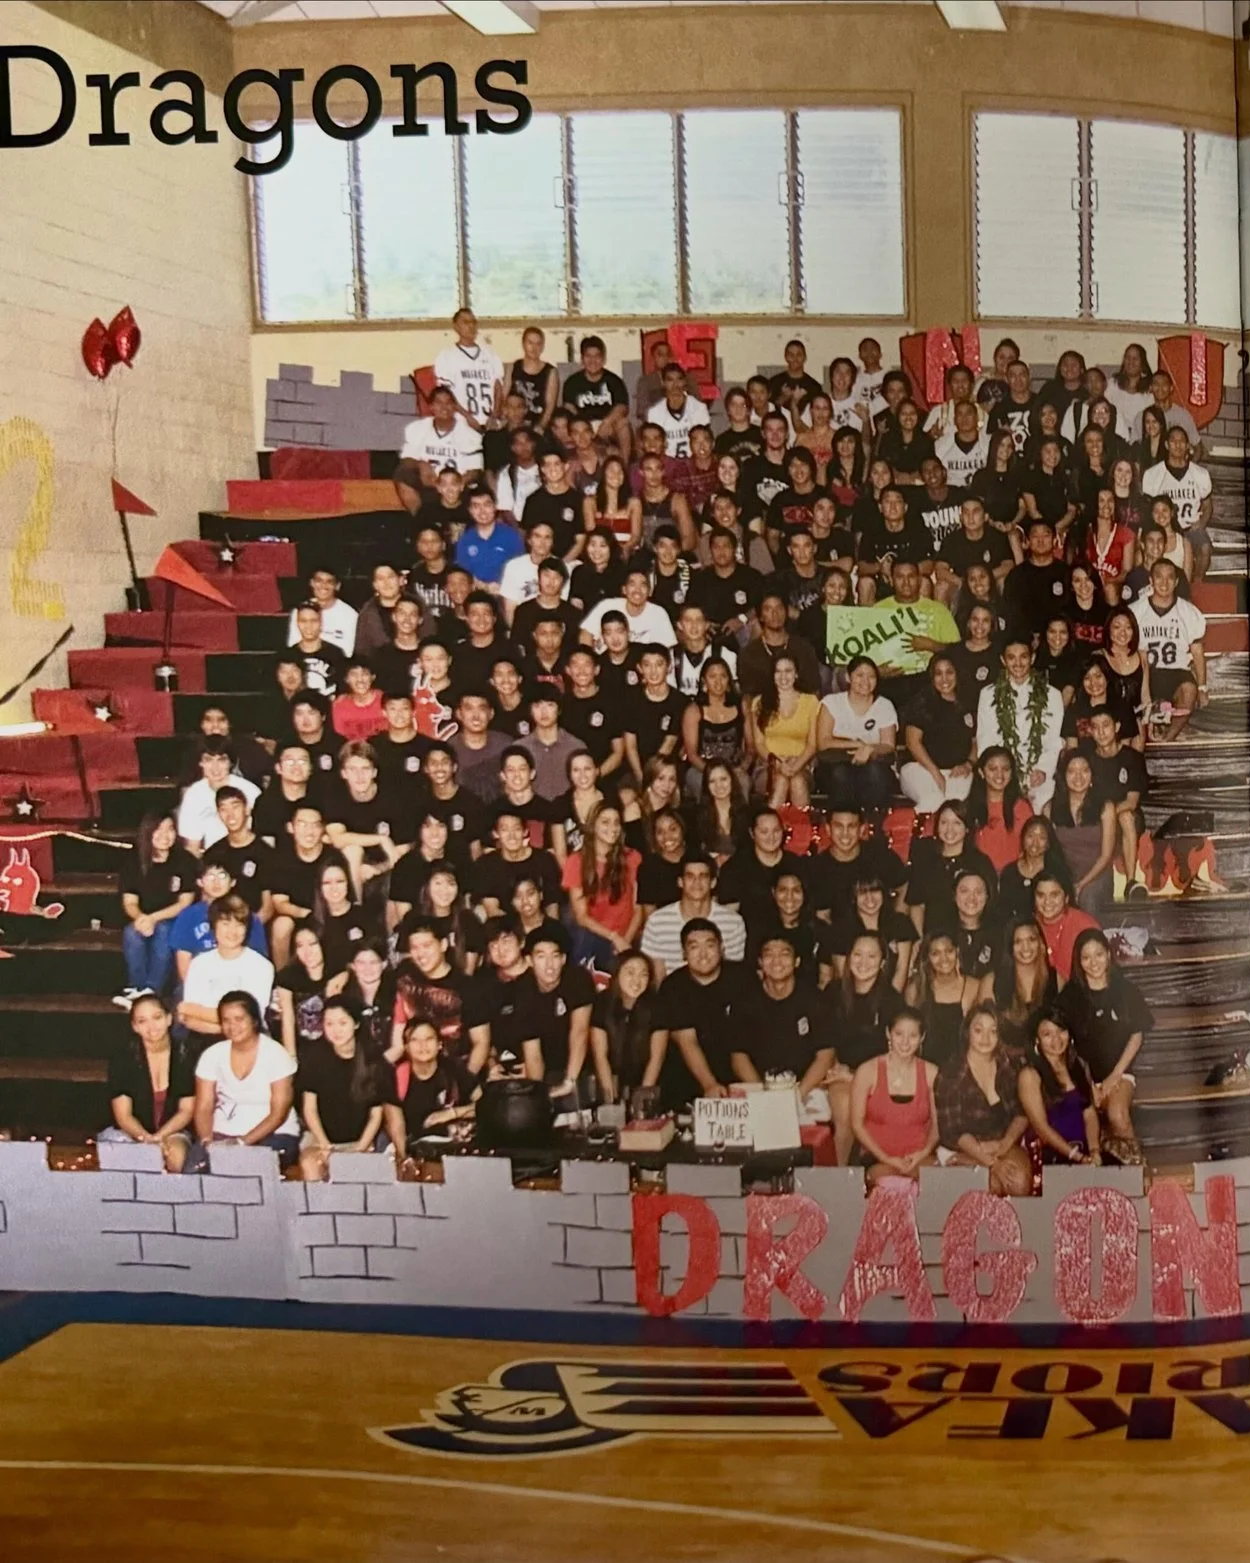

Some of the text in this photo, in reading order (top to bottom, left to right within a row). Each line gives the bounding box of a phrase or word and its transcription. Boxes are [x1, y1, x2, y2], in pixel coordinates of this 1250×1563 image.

[466, 383, 492, 416] 85
[0, 414, 66, 621] 2
[1147, 641, 1177, 668] 56
[698, 1100, 749, 1119] POTIONS
[706, 1121, 746, 1140] TABLE
